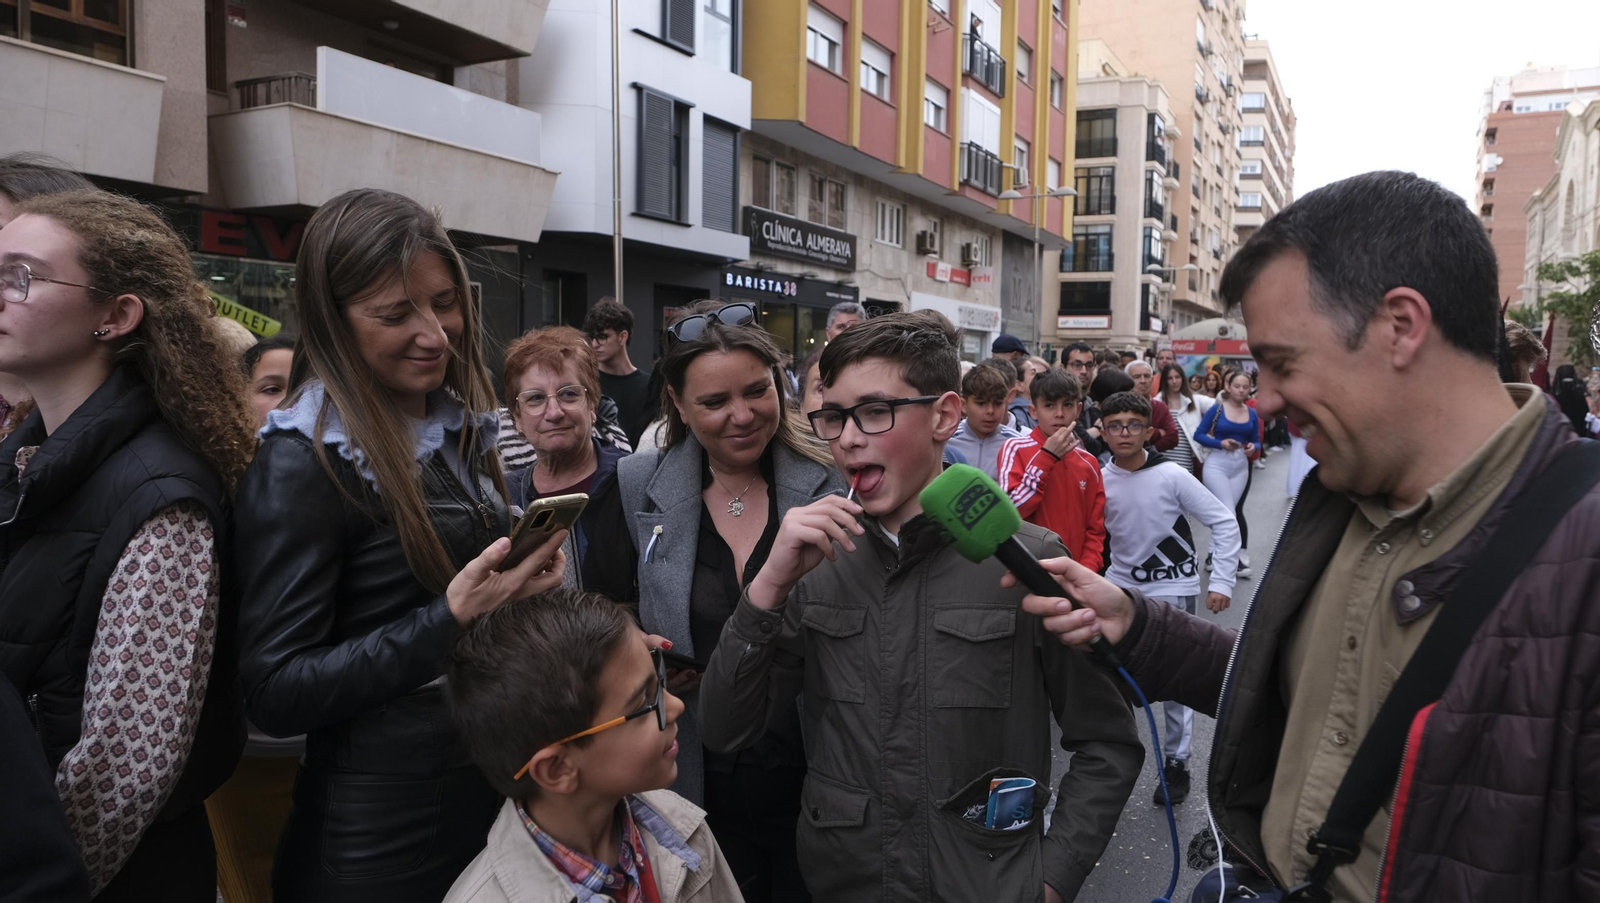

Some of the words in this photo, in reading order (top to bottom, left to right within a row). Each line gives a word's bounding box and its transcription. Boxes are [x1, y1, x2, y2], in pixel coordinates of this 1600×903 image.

[762, 220, 803, 247] CLÍNICA
[806, 232, 851, 258] ALMERAYA
[214, 297, 269, 332] OUTLET
[1072, 319, 1106, 327] Manpower
[1173, 342, 1196, 351] Coca-Cola
[967, 494, 993, 519] CERO
[1131, 555, 1198, 582] adid
